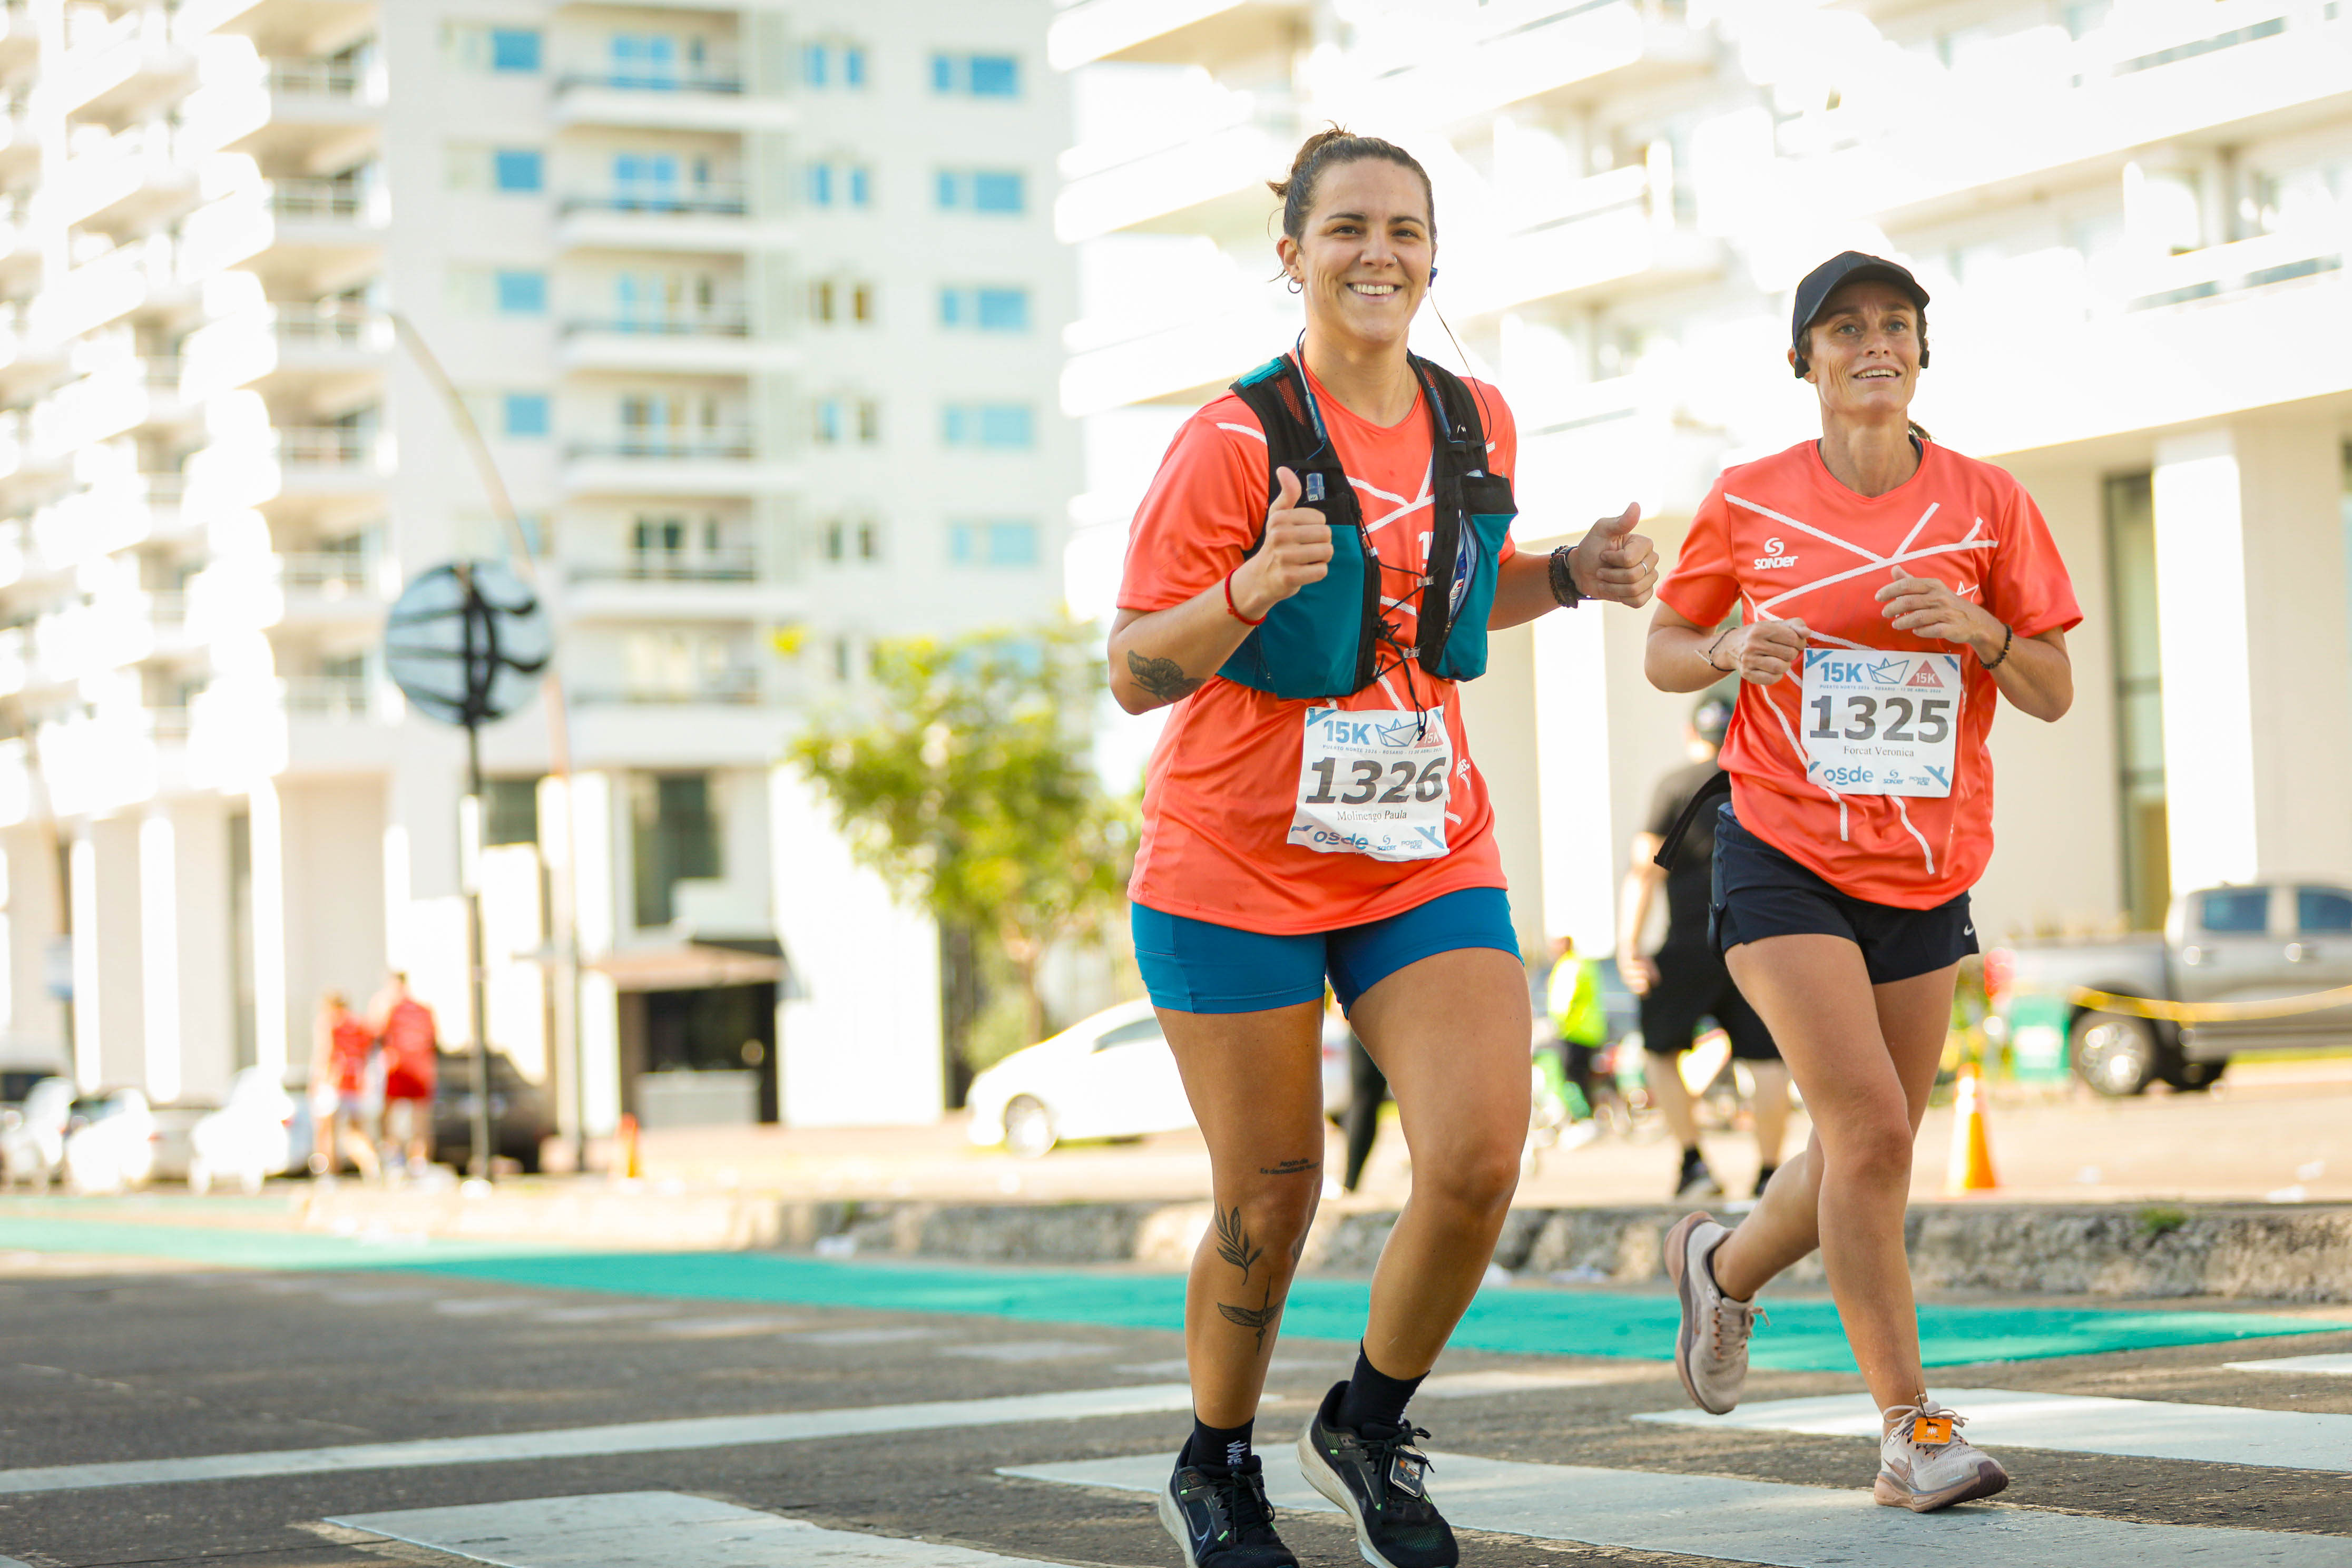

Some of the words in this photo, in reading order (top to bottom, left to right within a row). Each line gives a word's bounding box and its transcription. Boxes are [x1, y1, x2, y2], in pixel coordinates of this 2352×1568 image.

[1820, 662, 1863, 682] 15K
[1916, 672, 1936, 684] 15K
[1810, 695, 1951, 743] 1325
[1324, 720, 1371, 745] 15K
[1424, 731, 1439, 743] 15K
[1844, 745, 1871, 755] Forcat
[1875, 747, 1914, 757] Veronica
[1305, 757, 1446, 805] 1326
[1824, 766, 1874, 786] osde
[1337, 811, 1382, 822] Molinengo
[1384, 809, 1407, 820] Paula
[1314, 830, 1369, 850] osde
